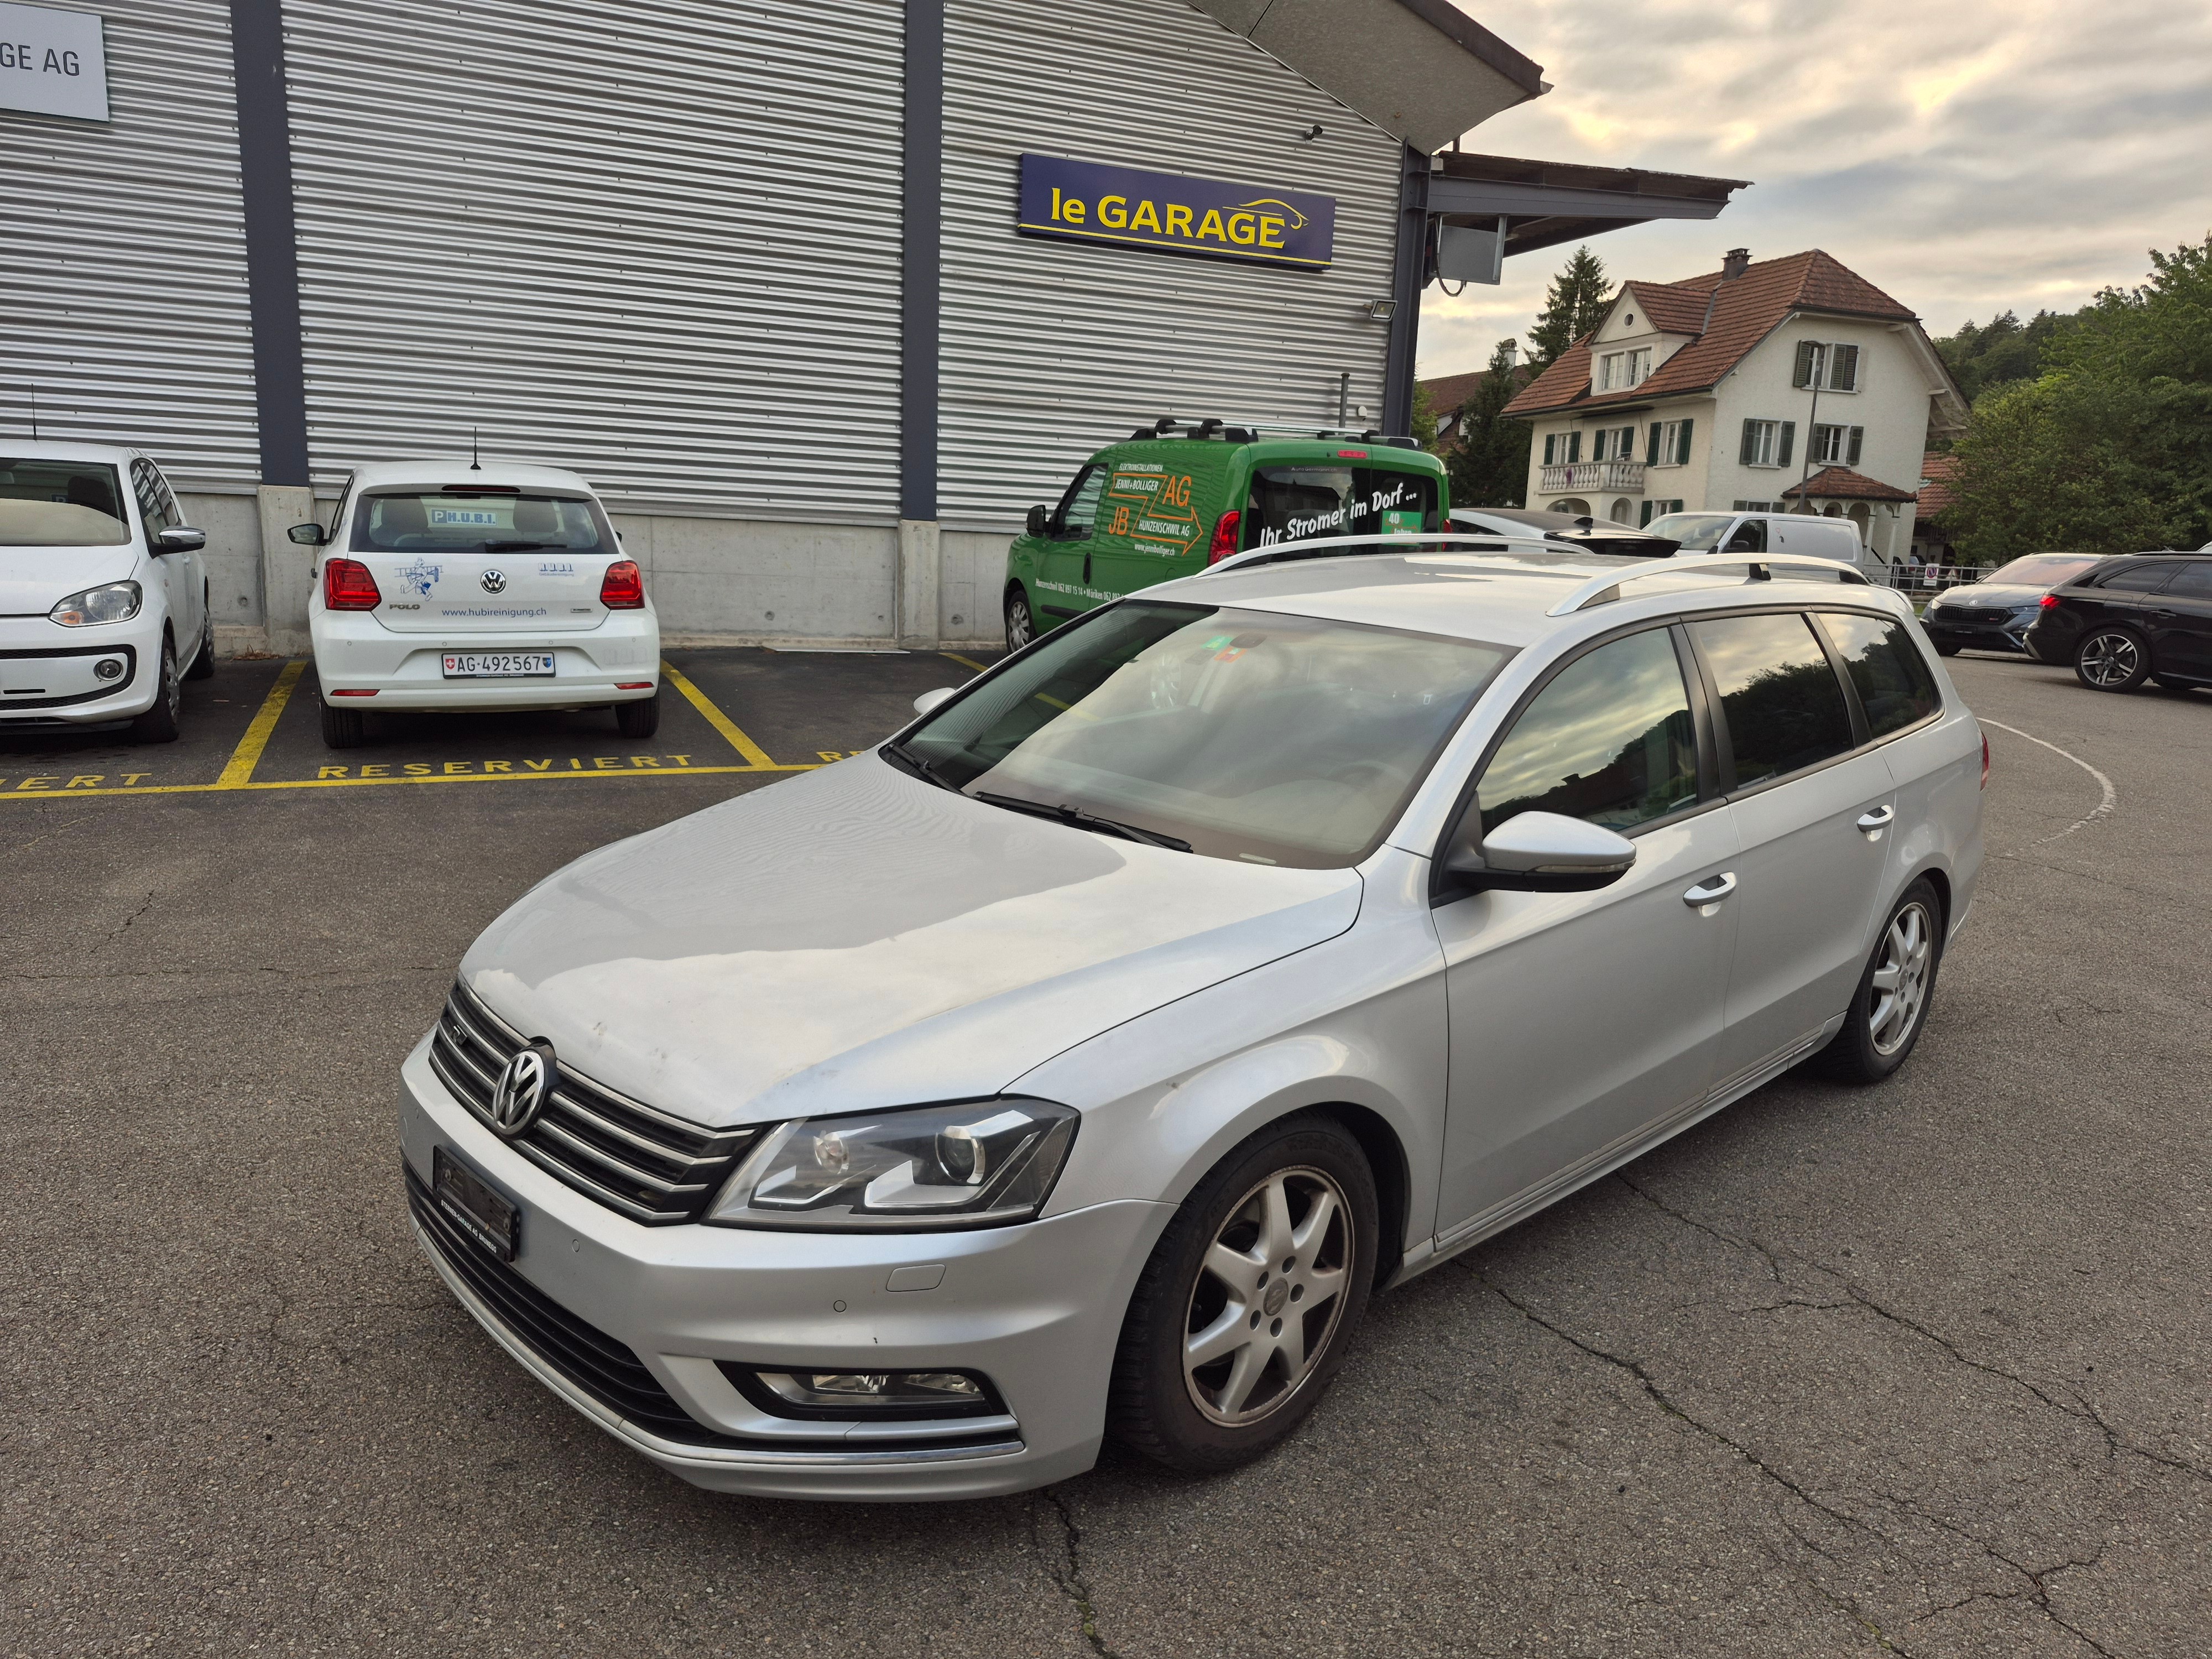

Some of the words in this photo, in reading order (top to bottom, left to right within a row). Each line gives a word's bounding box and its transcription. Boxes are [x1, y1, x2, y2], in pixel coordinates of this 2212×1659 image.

[43, 48, 80, 76] AG
[1051, 187, 1086, 224] le
[1096, 195, 1285, 249] GARAGE
[1119, 463, 1164, 472] ELEKTROINSTALLATIONEN
[1115, 479, 1159, 491] JENNI+BOLLIGER
[1162, 476, 1192, 507] AG
[1108, 507, 1129, 535] JB
[1139, 520, 1180, 536] HUNZENSCHWIL
[1180, 525, 1190, 537] AG
[1260, 526, 1282, 547] Ihr
[1286, 507, 1345, 540] Stromer
[1350, 499, 1367, 520] im
[1389, 513, 1400, 524] 40
[1073, 586, 1077, 595] 15
[1078, 586, 1083, 596] 14
[441, 608, 546, 618] www.hubireinigung.ch
[318, 755, 691, 779] RESERVIERT
